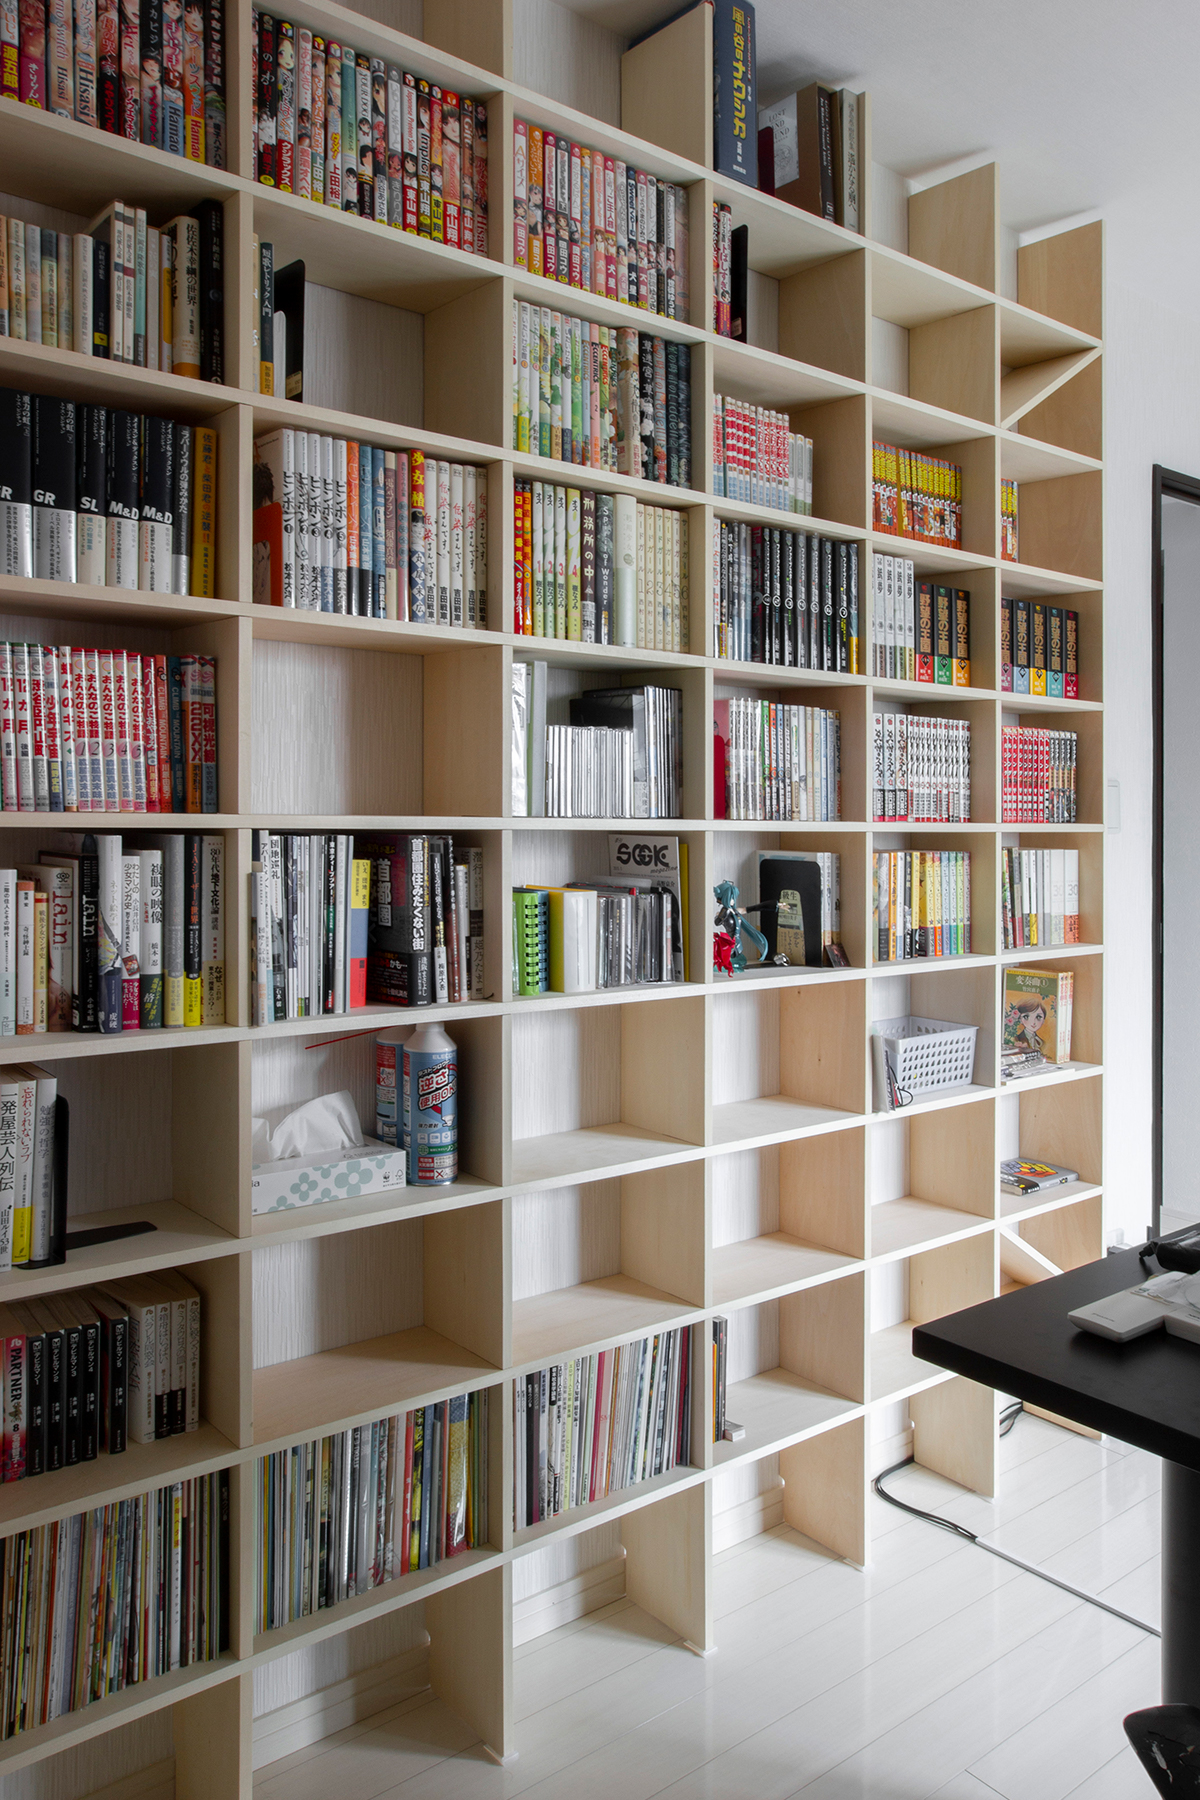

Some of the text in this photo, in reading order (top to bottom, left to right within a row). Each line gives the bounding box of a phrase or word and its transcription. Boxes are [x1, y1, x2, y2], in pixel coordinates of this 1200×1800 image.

[3, 45, 18, 88] 源五郎
[57, 66, 68, 101] Hisasi
[79, 67, 94, 118] Hisasi
[169, 106, 181, 153] Hamao
[191, 119, 201, 158] Hamao
[591, 341, 599, 384] ECCENTRICS
[411, 452, 424, 508] 少女椿
[33, 489, 56, 507] GR
[80, 497, 98, 512] SL
[109, 501, 140, 521] M&D
[143, 505, 173, 525] M&D
[583, 497, 595, 581] 刑務所の中
[413, 553, 424, 616] 丸尾末広
[537, 561, 541, 573] 1
[548, 561, 553, 574] 2
[559, 563, 564, 576] 3
[572, 564, 578, 577] 4
[427, 586, 435, 621] 吉田戦車
[440, 586, 448, 620] 吉田戦車
[601, 568, 610, 606] Wonder
[638, 578, 644, 594] 1
[646, 581, 653, 595] 2
[656, 582, 663, 597] 3
[664, 583, 672, 598] 4
[673, 583, 680, 599] 5
[681, 585, 689, 600] 6
[454, 589, 462, 622] 吉田戦車
[81, 741, 87, 756] 1
[92, 742, 100, 756] 2
[107, 743, 114, 758] 3
[121, 743, 128, 755] 4
[136, 745, 142, 757] 5
[159, 718, 168, 760] MOUNTAIN
[173, 718, 181, 760] MOUNTAIN
[271, 840, 280, 880] 団地巡礼
[472, 851, 482, 879] 潜行
[124, 863, 132, 910] 少女マンガ史
[132, 864, 140, 894] わたしの
[151, 863, 162, 924] 複眼の映像
[377, 859, 392, 927] 首都圏
[411, 839, 424, 951] 首都圏住みたくない街
[53, 890, 73, 945] lain
[82, 894, 98, 938] lain
[1016, 974, 1039, 987] 変奏曲
[109, 1013, 117, 1030] 虎硬
[420, 1070, 448, 1093] 逆さ
[0, 1092, 17, 1191] 一発屋芸人列伝
[21, 1086, 34, 1163] 忘れられないラブ
[38, 1105, 50, 1158] 勉強の哲学
[144, 1315, 155, 1368] パラレル同窓会
[159, 1314, 168, 1364] 箱舟はいっぱい
[189, 1307, 199, 1361] 気楽に殺ろうよ
[9, 1347, 22, 1433] PARTNER 8
